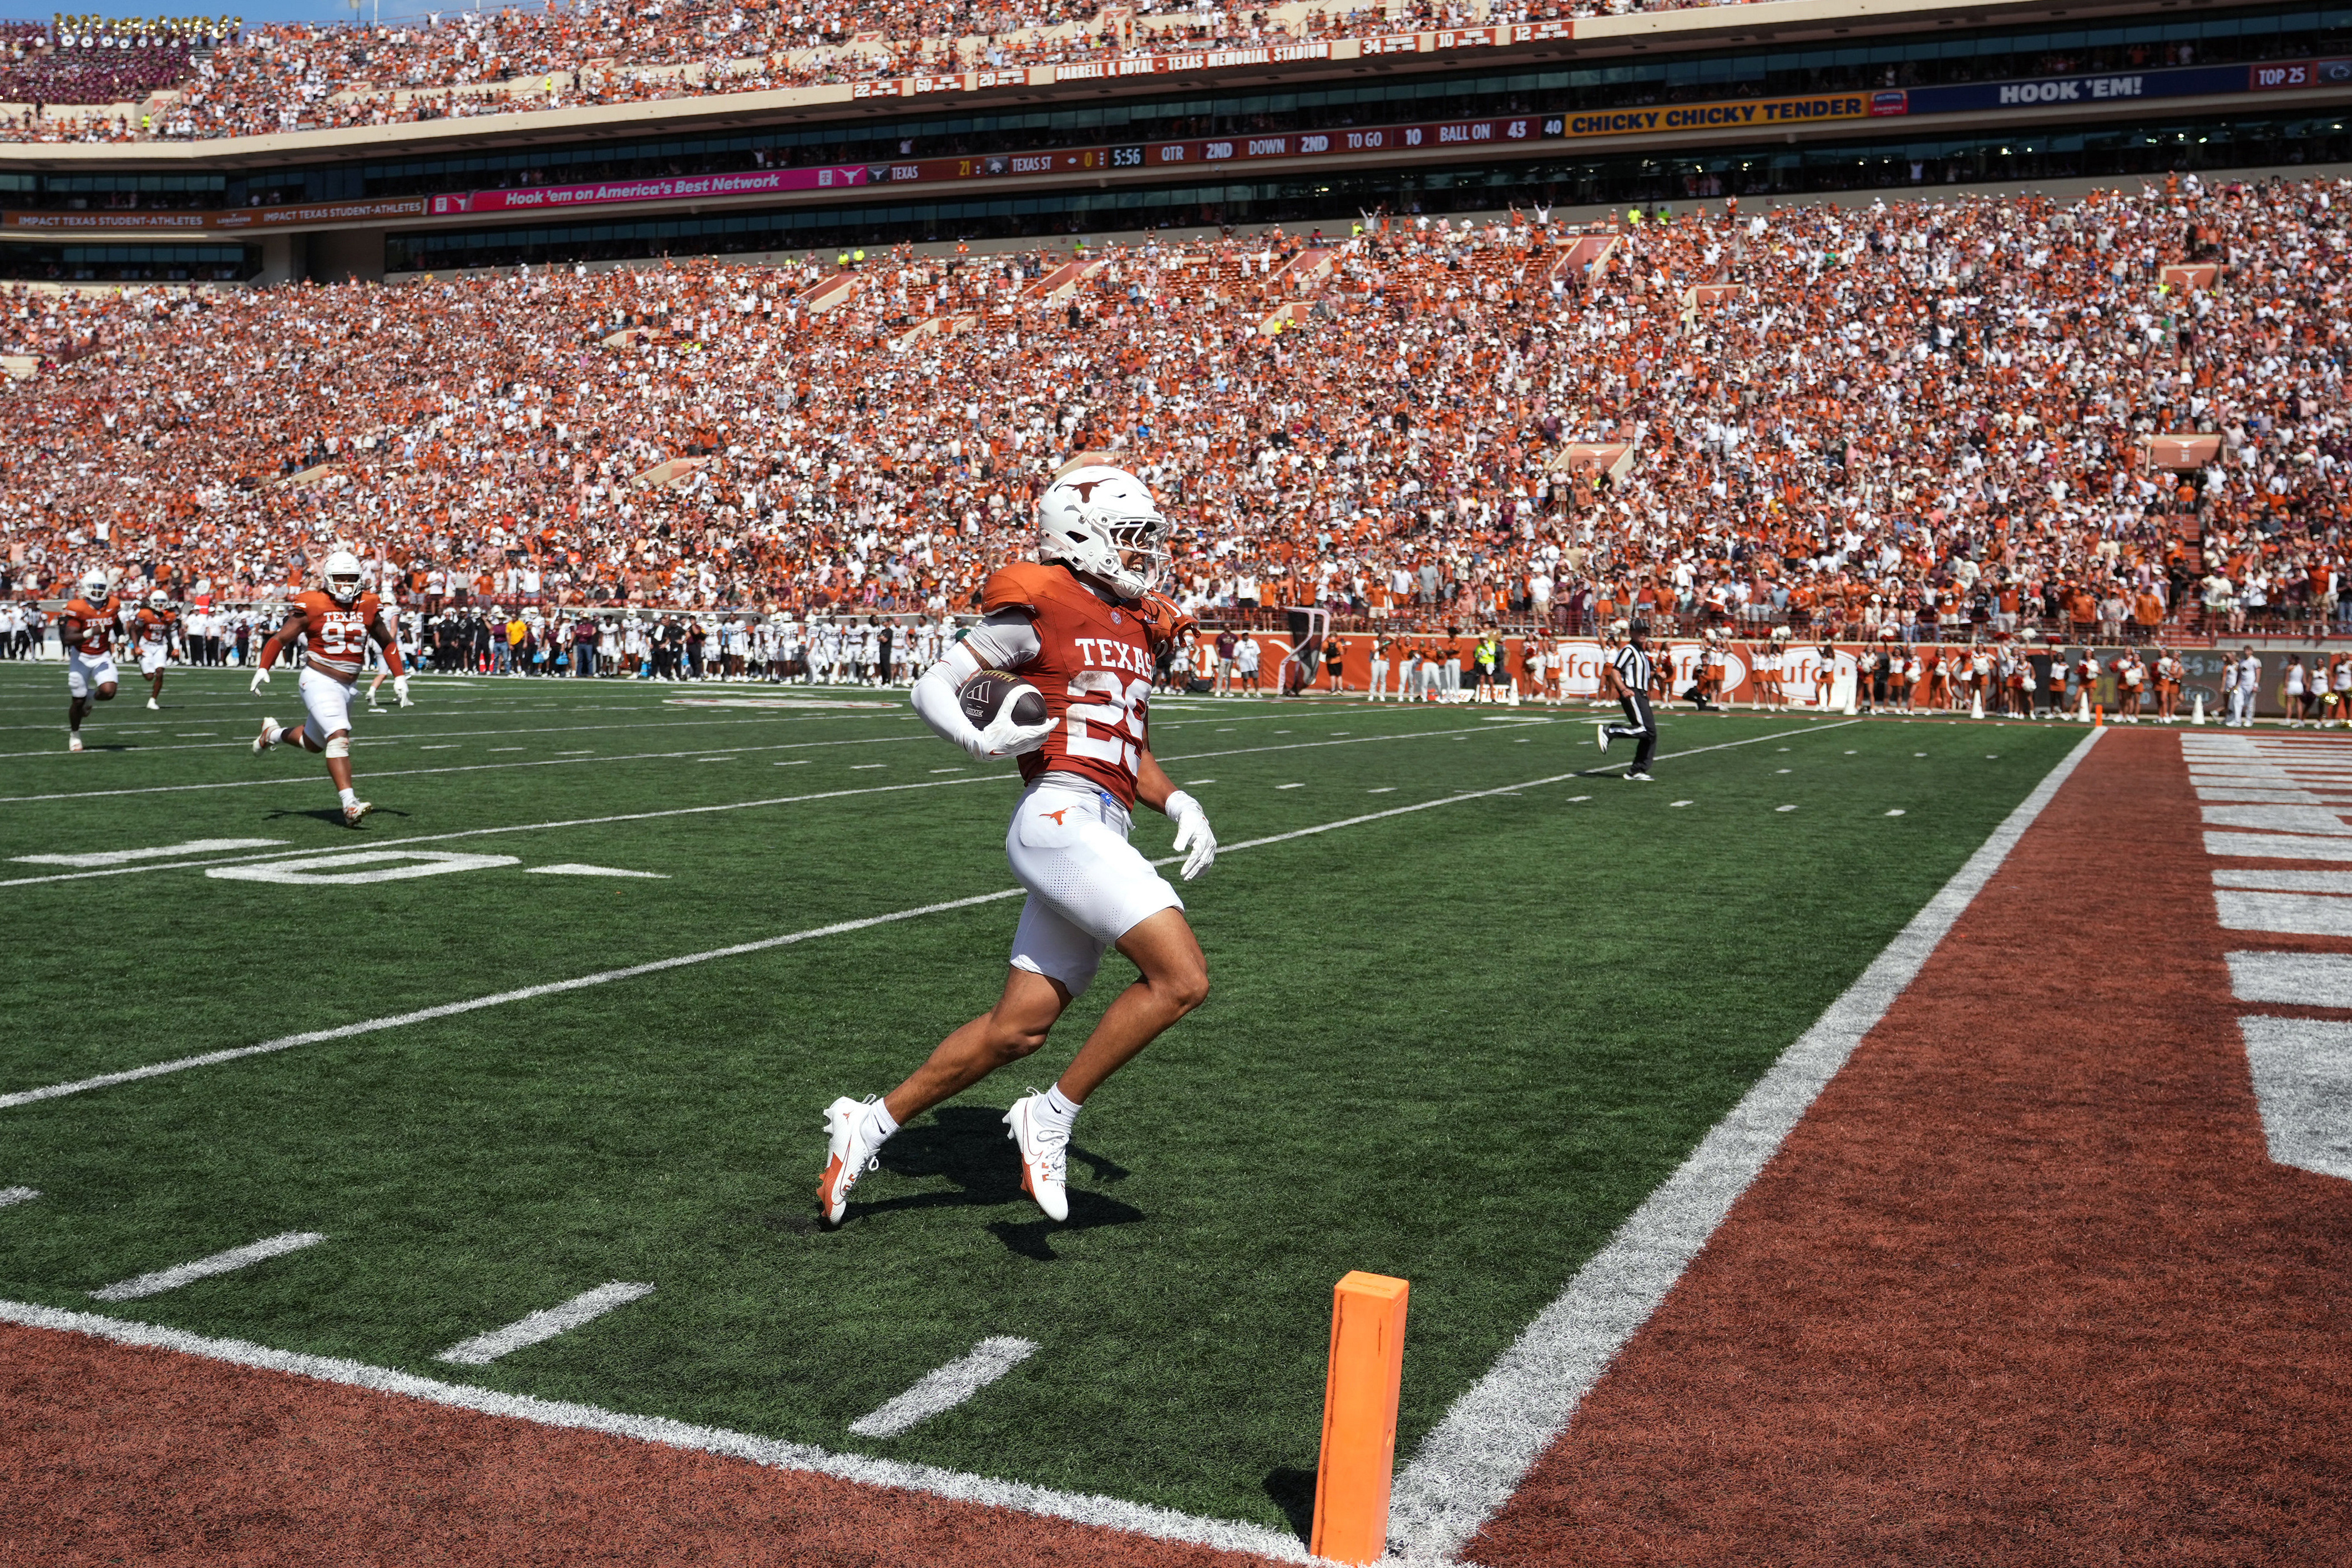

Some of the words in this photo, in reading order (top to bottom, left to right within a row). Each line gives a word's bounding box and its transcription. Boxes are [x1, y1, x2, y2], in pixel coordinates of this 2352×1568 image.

[1438, 33, 1454, 48] 10
[1515, 27, 1531, 41] 12
[1363, 39, 1381, 54] 34
[1056, 64, 1104, 80] DARRELL
[1108, 62, 1116, 76] K
[1119, 58, 1155, 75] ROYAL
[1167, 55, 1203, 70] TEXAS
[1207, 49, 1269, 67] MEMORIAL
[1273, 43, 1328, 61] STADIUM
[979, 73, 996, 87] 20
[2258, 69, 2285, 85] TOP
[2289, 67, 2305, 83] 25
[854, 84, 871, 98] 22
[915, 79, 932, 92] 60
[2000, 80, 2080, 104] HOOK
[2085, 77, 2143, 97] 'EM!
[1572, 112, 1659, 133] CHICKY
[1666, 105, 1756, 127] CHICKY
[1764, 98, 1862, 120] TENDER
[1440, 126, 1469, 142] BALL
[1472, 124, 1490, 140] ON
[1508, 121, 1526, 138] 43
[1545, 120, 1562, 134] 40
[1249, 139, 1285, 155] DOWN
[1301, 135, 1328, 153] 2ND
[1347, 134, 1362, 149] TO
[1365, 132, 1382, 147] GO
[1405, 128, 1422, 145] 10
[1114, 148, 1140, 165] 5:56
[1162, 146, 1183, 161] QTR
[1206, 142, 1232, 159] 2ND
[892, 166, 918, 180] TEXAS
[960, 160, 970, 176] 21
[1013, 157, 1039, 172] TEXAS
[1041, 156, 1052, 170] ST
[1084, 152, 1092, 167] 0
[505, 190, 543, 205] Hook
[547, 190, 573, 204] 'em
[575, 189, 593, 201] on
[596, 183, 671, 199] America's
[675, 179, 709, 193] Best
[712, 174, 780, 190] Network
[19, 216, 59, 226] IMPACT
[62, 216, 95, 226] TEXAS
[99, 216, 203, 226] STUDENT-ATHLETES
[264, 211, 297, 222] IMPACT
[300, 209, 328, 220] TEXAS
[330, 202, 421, 218] STUDENT-ATHLETES
[85, 617, 113, 627] TEXAS
[323, 611, 364, 623] TEXAS
[321, 621, 367, 654] 93
[1075, 638, 1153, 681] TEXAS
[966, 707, 983, 717] DIME
